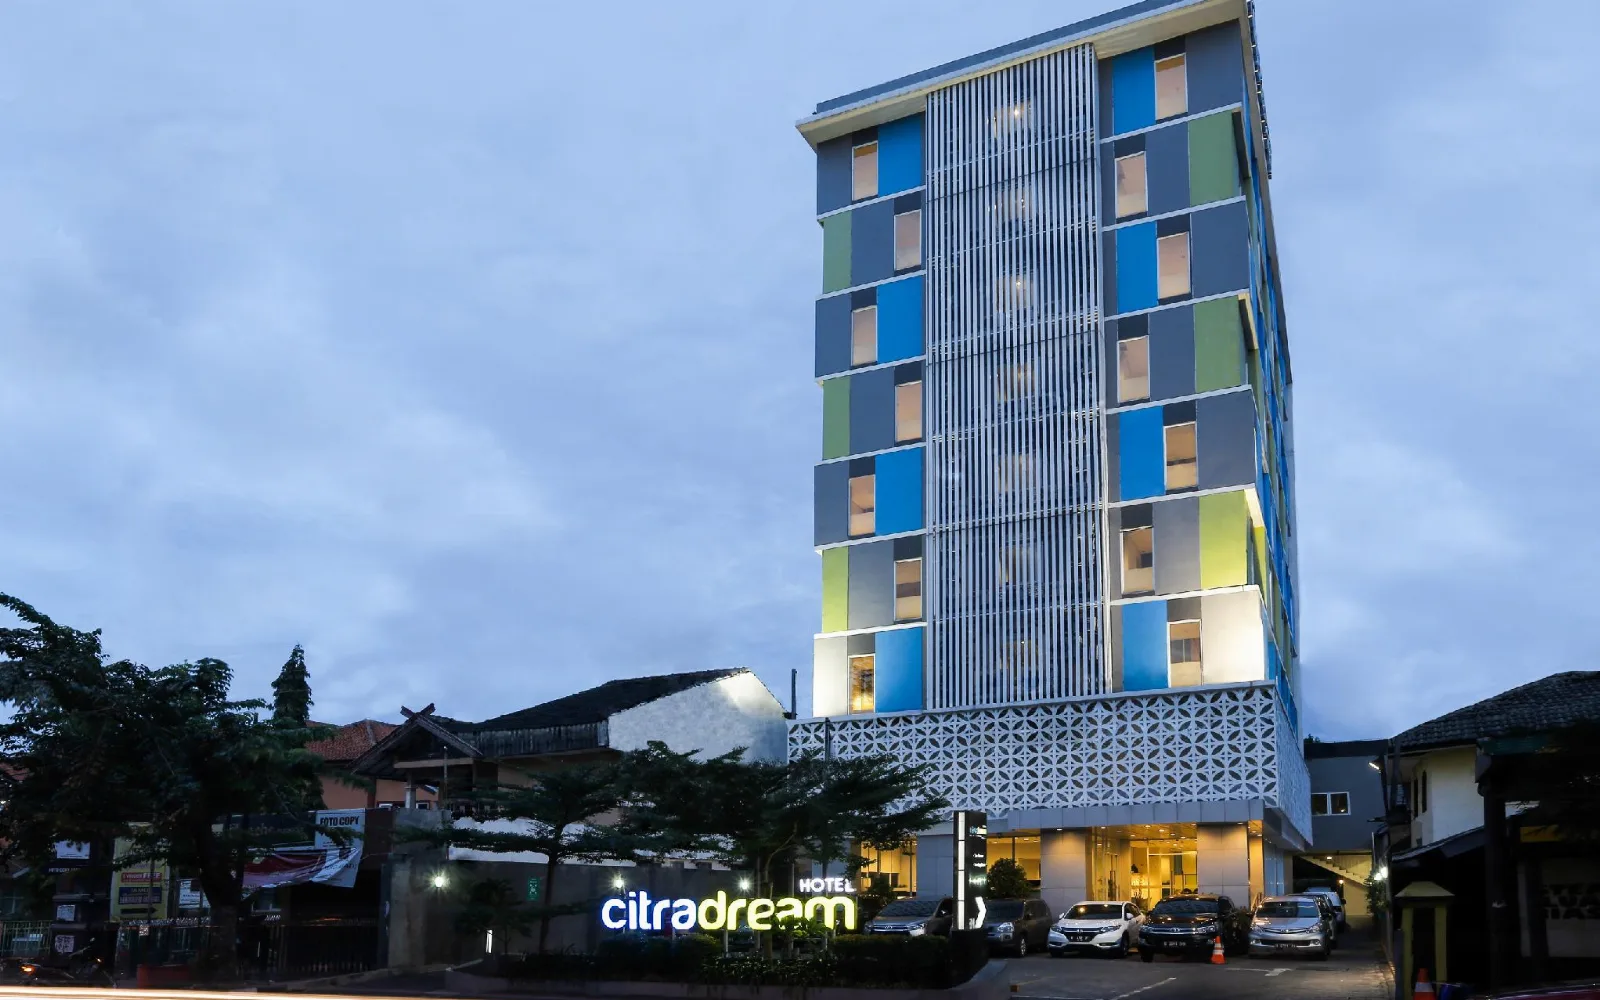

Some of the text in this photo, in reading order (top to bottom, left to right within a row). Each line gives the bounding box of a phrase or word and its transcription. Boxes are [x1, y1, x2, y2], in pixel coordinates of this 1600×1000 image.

[320, 816, 359, 826] FOTO COPY
[799, 878, 856, 893] HOTEL
[601, 890, 856, 931] citradream
